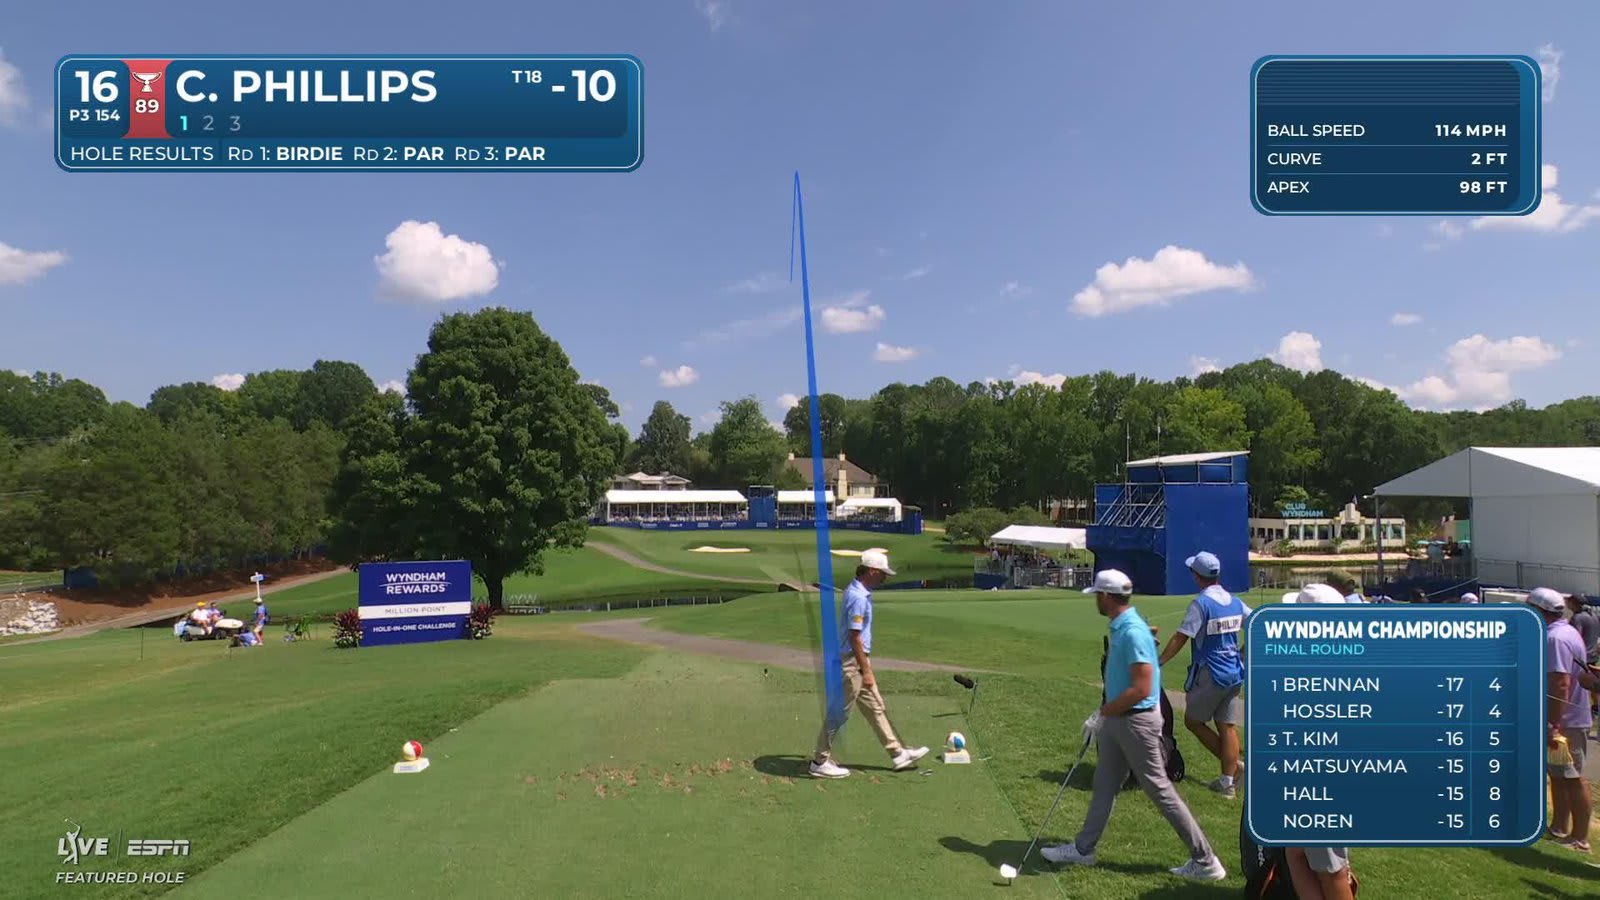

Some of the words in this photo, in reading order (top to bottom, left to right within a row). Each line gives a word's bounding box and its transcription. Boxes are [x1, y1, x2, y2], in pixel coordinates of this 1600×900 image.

[1281, 510, 1324, 518] WYNDHAM
[386, 572, 446, 582] WYNDHAM
[386, 584, 446, 595] REWARDS
[384, 607, 419, 615] MILLION
[372, 625, 417, 633] HOLE-IN-ONE
[418, 622, 457, 631] CHALLENGE
